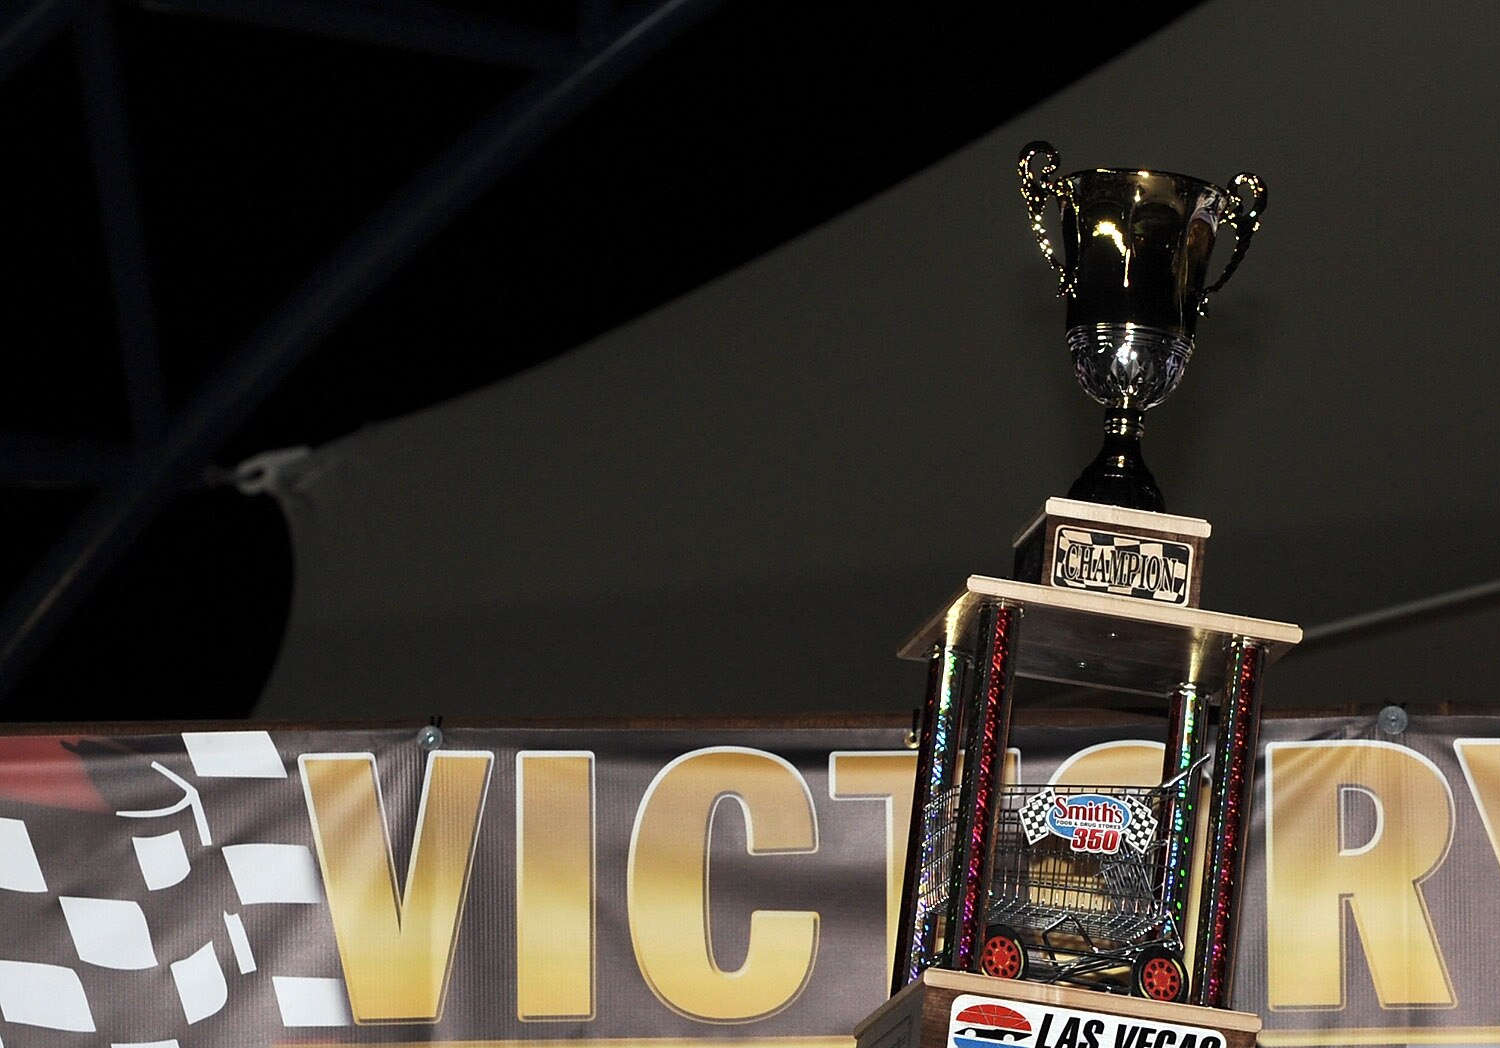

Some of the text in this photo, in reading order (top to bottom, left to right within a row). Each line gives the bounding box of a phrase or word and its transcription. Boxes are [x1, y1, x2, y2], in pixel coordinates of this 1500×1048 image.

[1064, 543, 1178, 593] CHAMPION
[1054, 796, 1123, 824] Smith's
[1071, 828, 1119, 851] 350
